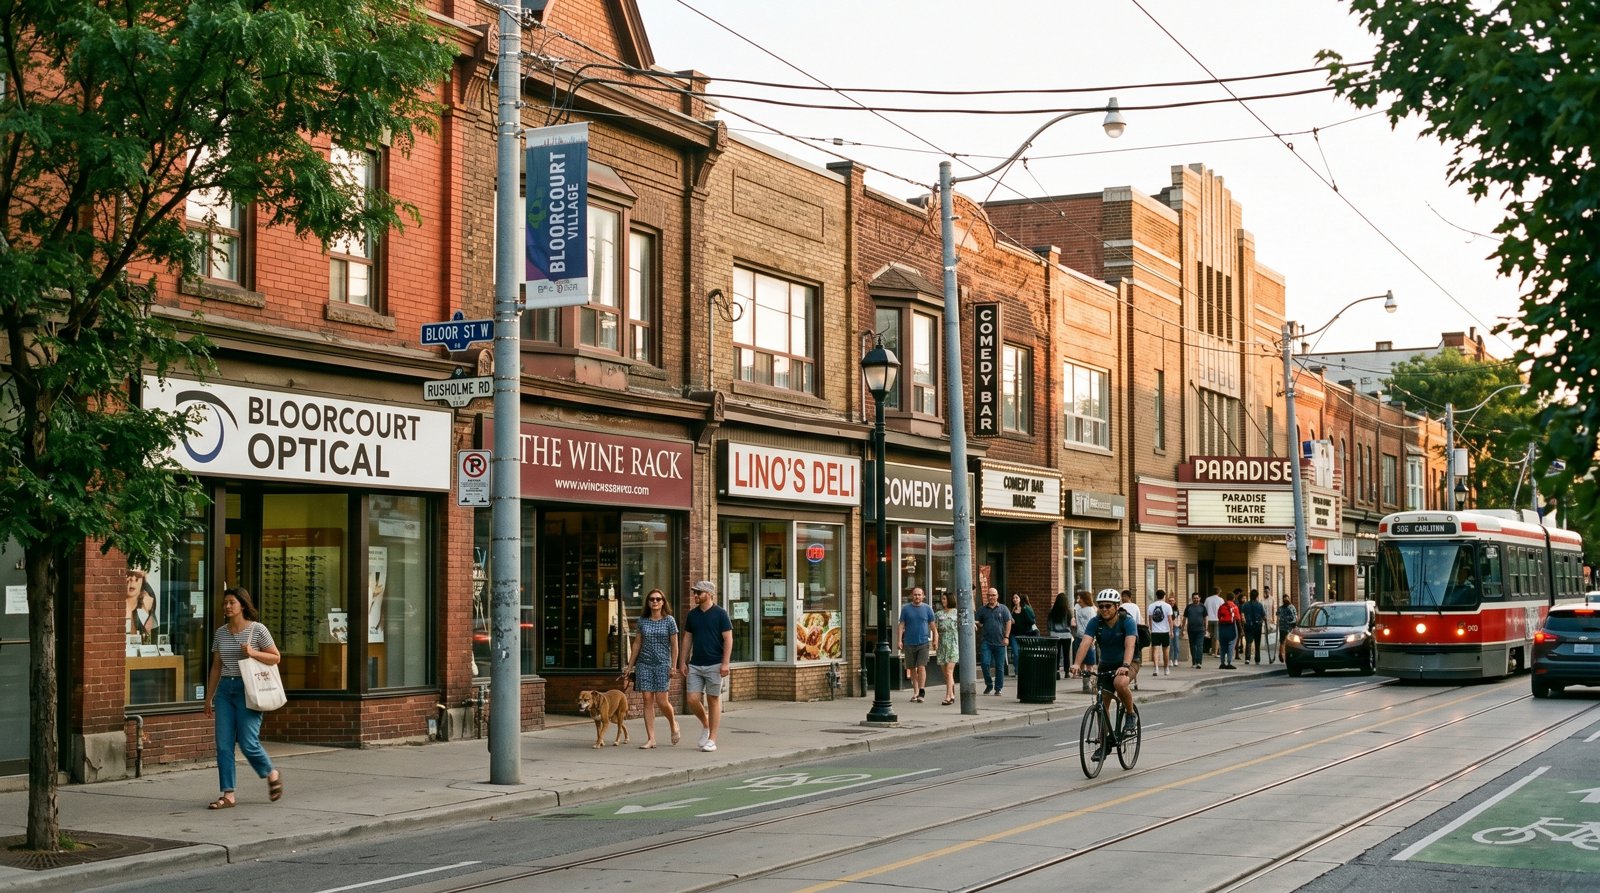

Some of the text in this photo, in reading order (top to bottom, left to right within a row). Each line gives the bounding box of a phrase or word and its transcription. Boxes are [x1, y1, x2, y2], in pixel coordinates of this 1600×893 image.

[549, 152, 566, 273] BLOORCOURT
[567, 183, 579, 240] VILLAGE
[426, 323, 489, 341] BLOOR ST W
[979, 309, 993, 430] COMEDY BAR
[427, 380, 490, 397] RUSHOLME RD
[248, 396, 421, 441] BLOORCOURT
[247, 432, 390, 478] OPTICAL
[519, 433, 683, 480] THE WINE RACK
[1195, 459, 1292, 482] PARADISE
[735, 451, 855, 497] LINO'S DELI
[1003, 475, 1044, 493] COMEDY BAR
[1222, 493, 1267, 503] PARADISE
[1225, 504, 1266, 514] THEATRE
[1227, 515, 1265, 524] THEATRE
